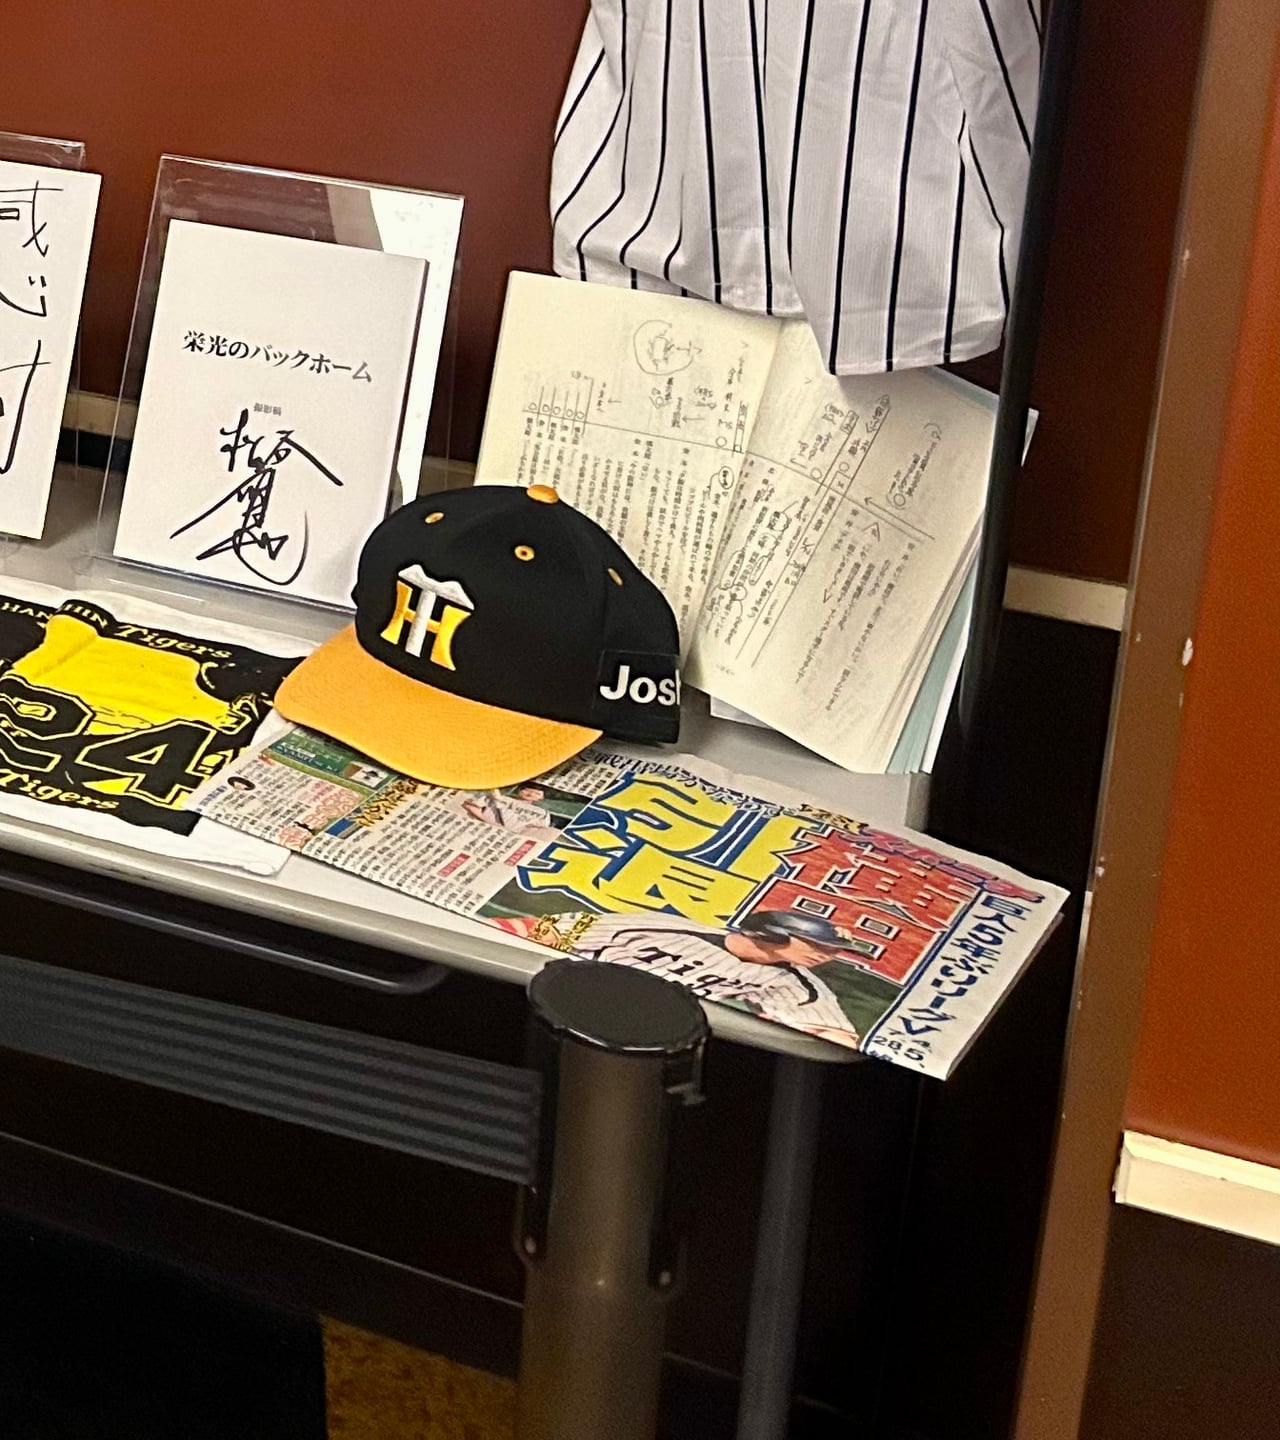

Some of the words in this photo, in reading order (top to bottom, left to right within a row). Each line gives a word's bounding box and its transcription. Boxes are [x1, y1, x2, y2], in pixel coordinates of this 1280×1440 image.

[182, 329, 373, 383] 栄光のバックホーム
[1, 601, 111, 633] HANHIN
[116, 624, 233, 660] Tigers
[517, 770, 825, 926] 引退
[740, 823, 981, 990] 横田
